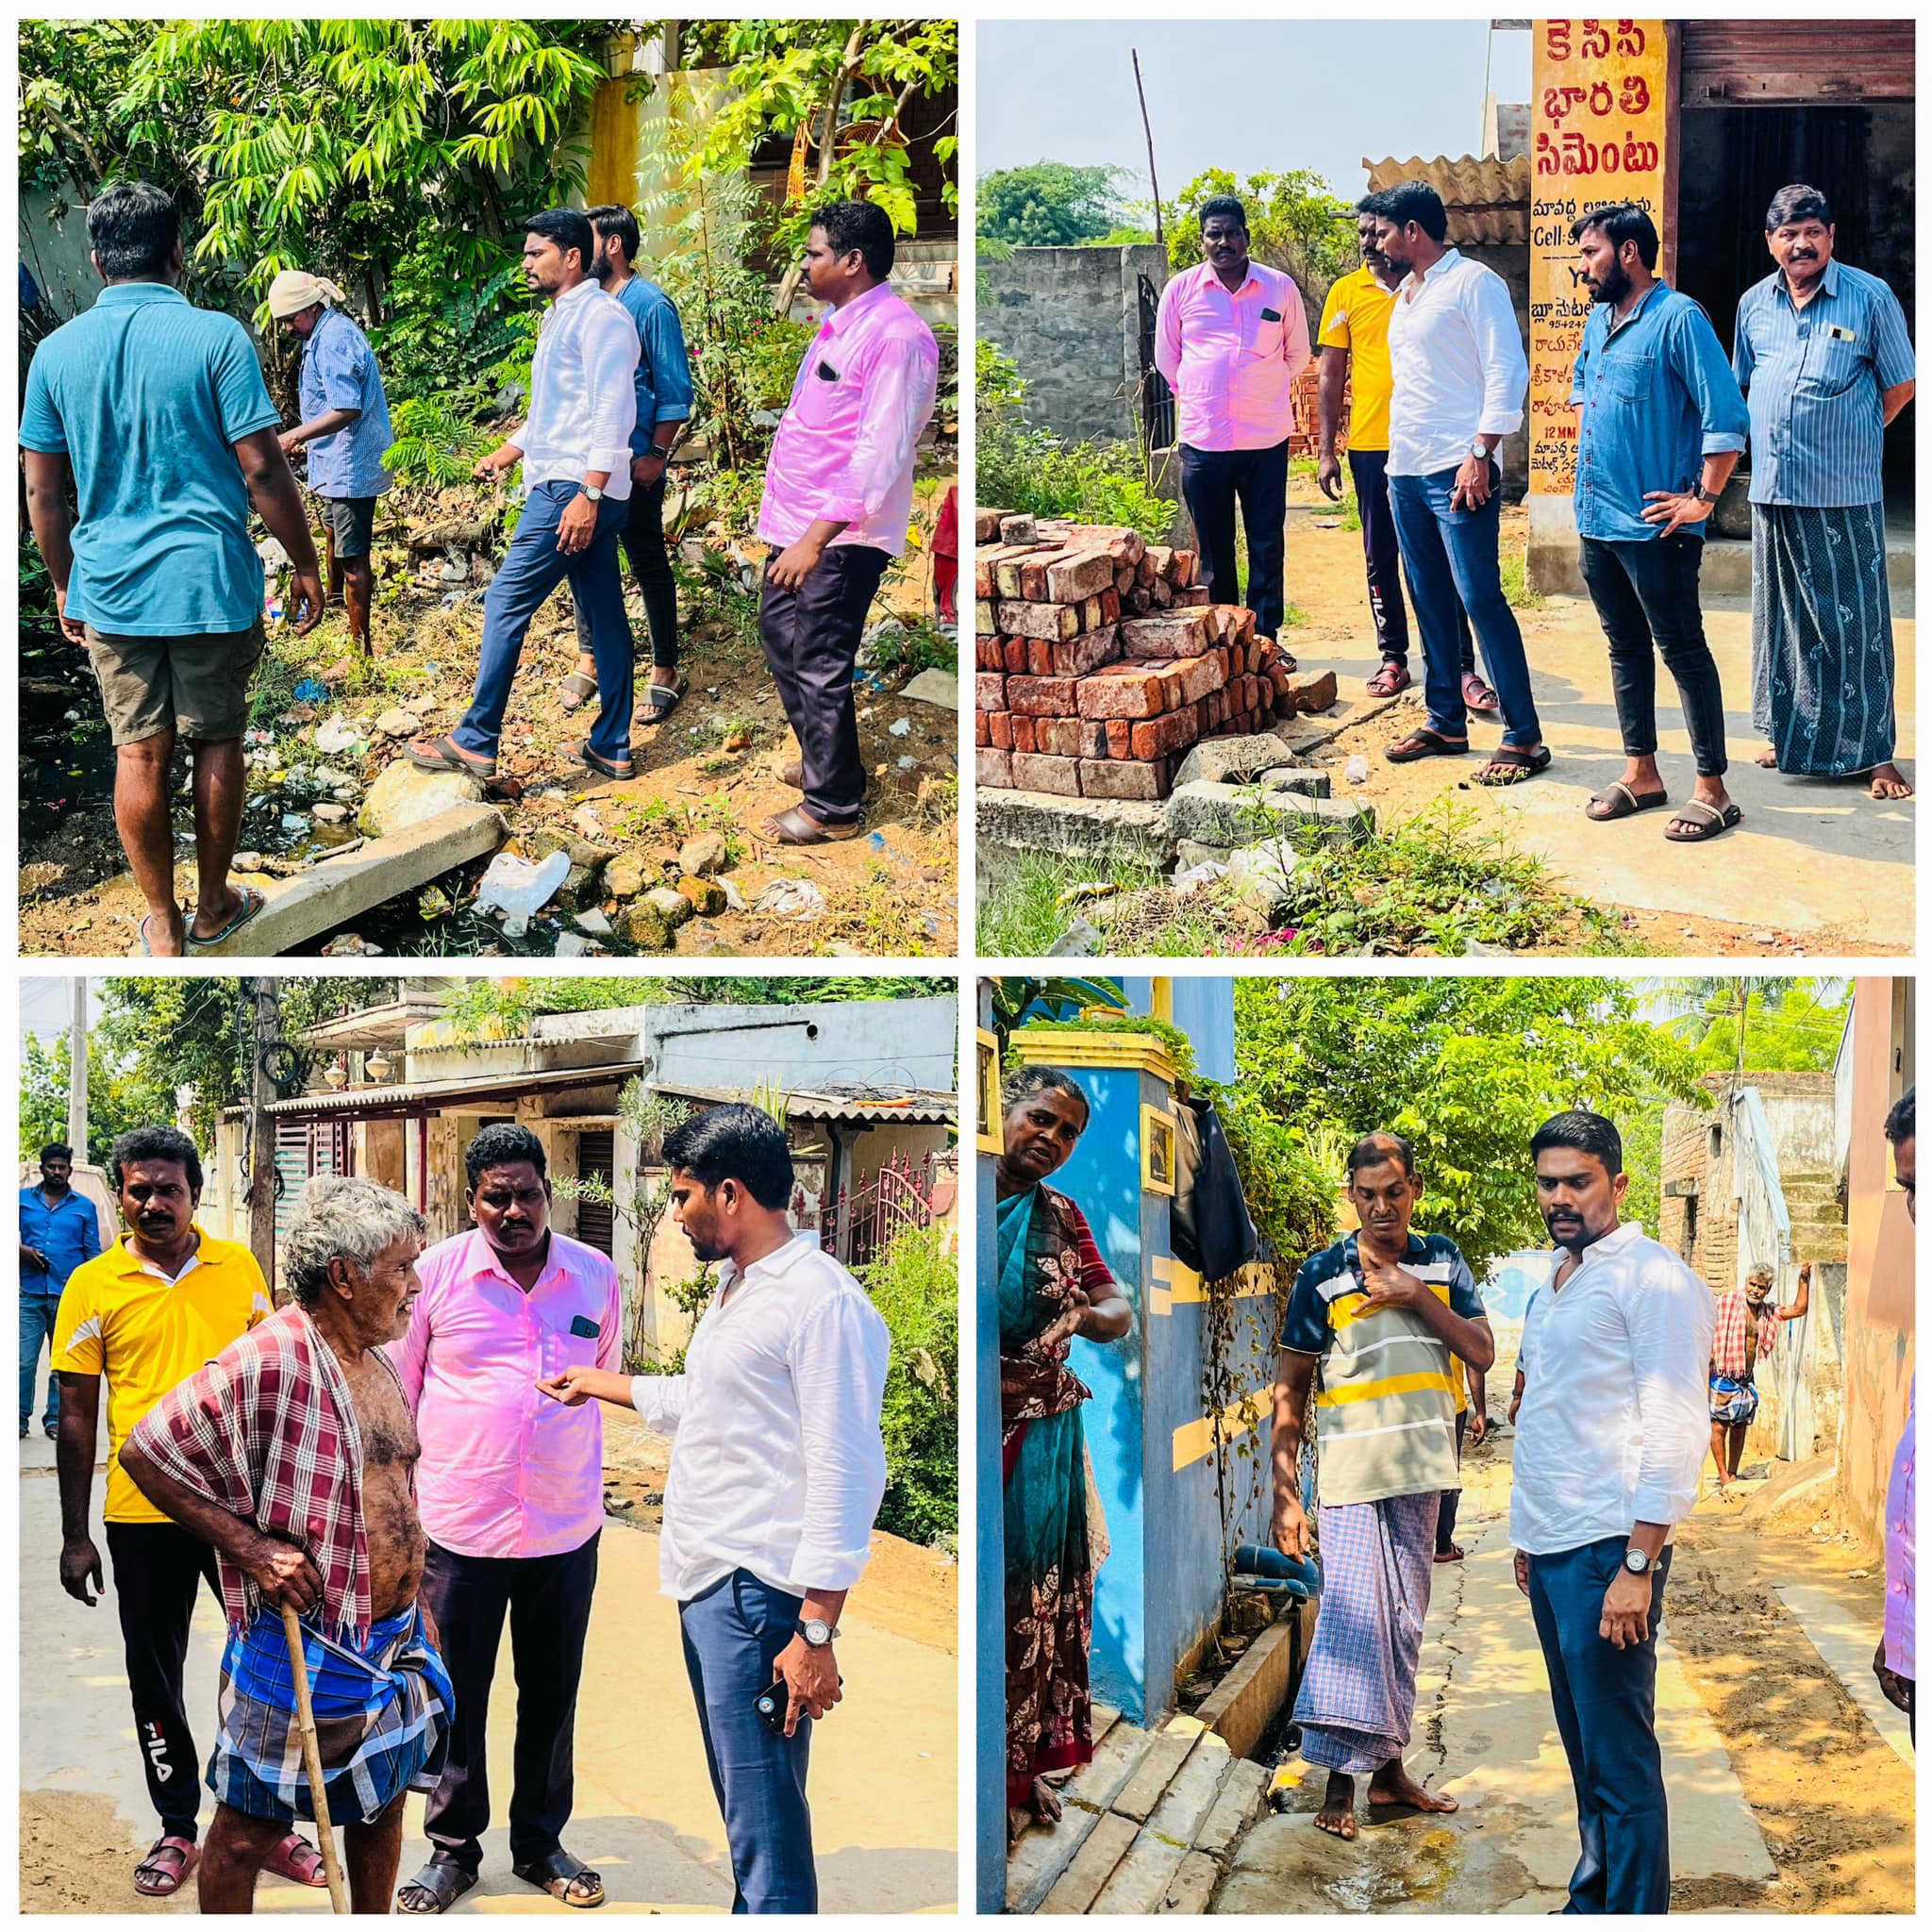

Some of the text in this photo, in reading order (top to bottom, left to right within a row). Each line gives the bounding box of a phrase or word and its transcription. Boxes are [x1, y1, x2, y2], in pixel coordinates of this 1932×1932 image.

[1544, 75, 1650, 129] భారతి
[1536, 131, 1658, 175] సిమెంటు
[1370, 584, 1388, 629] FILA
[143, 1720, 174, 1783] FILA
